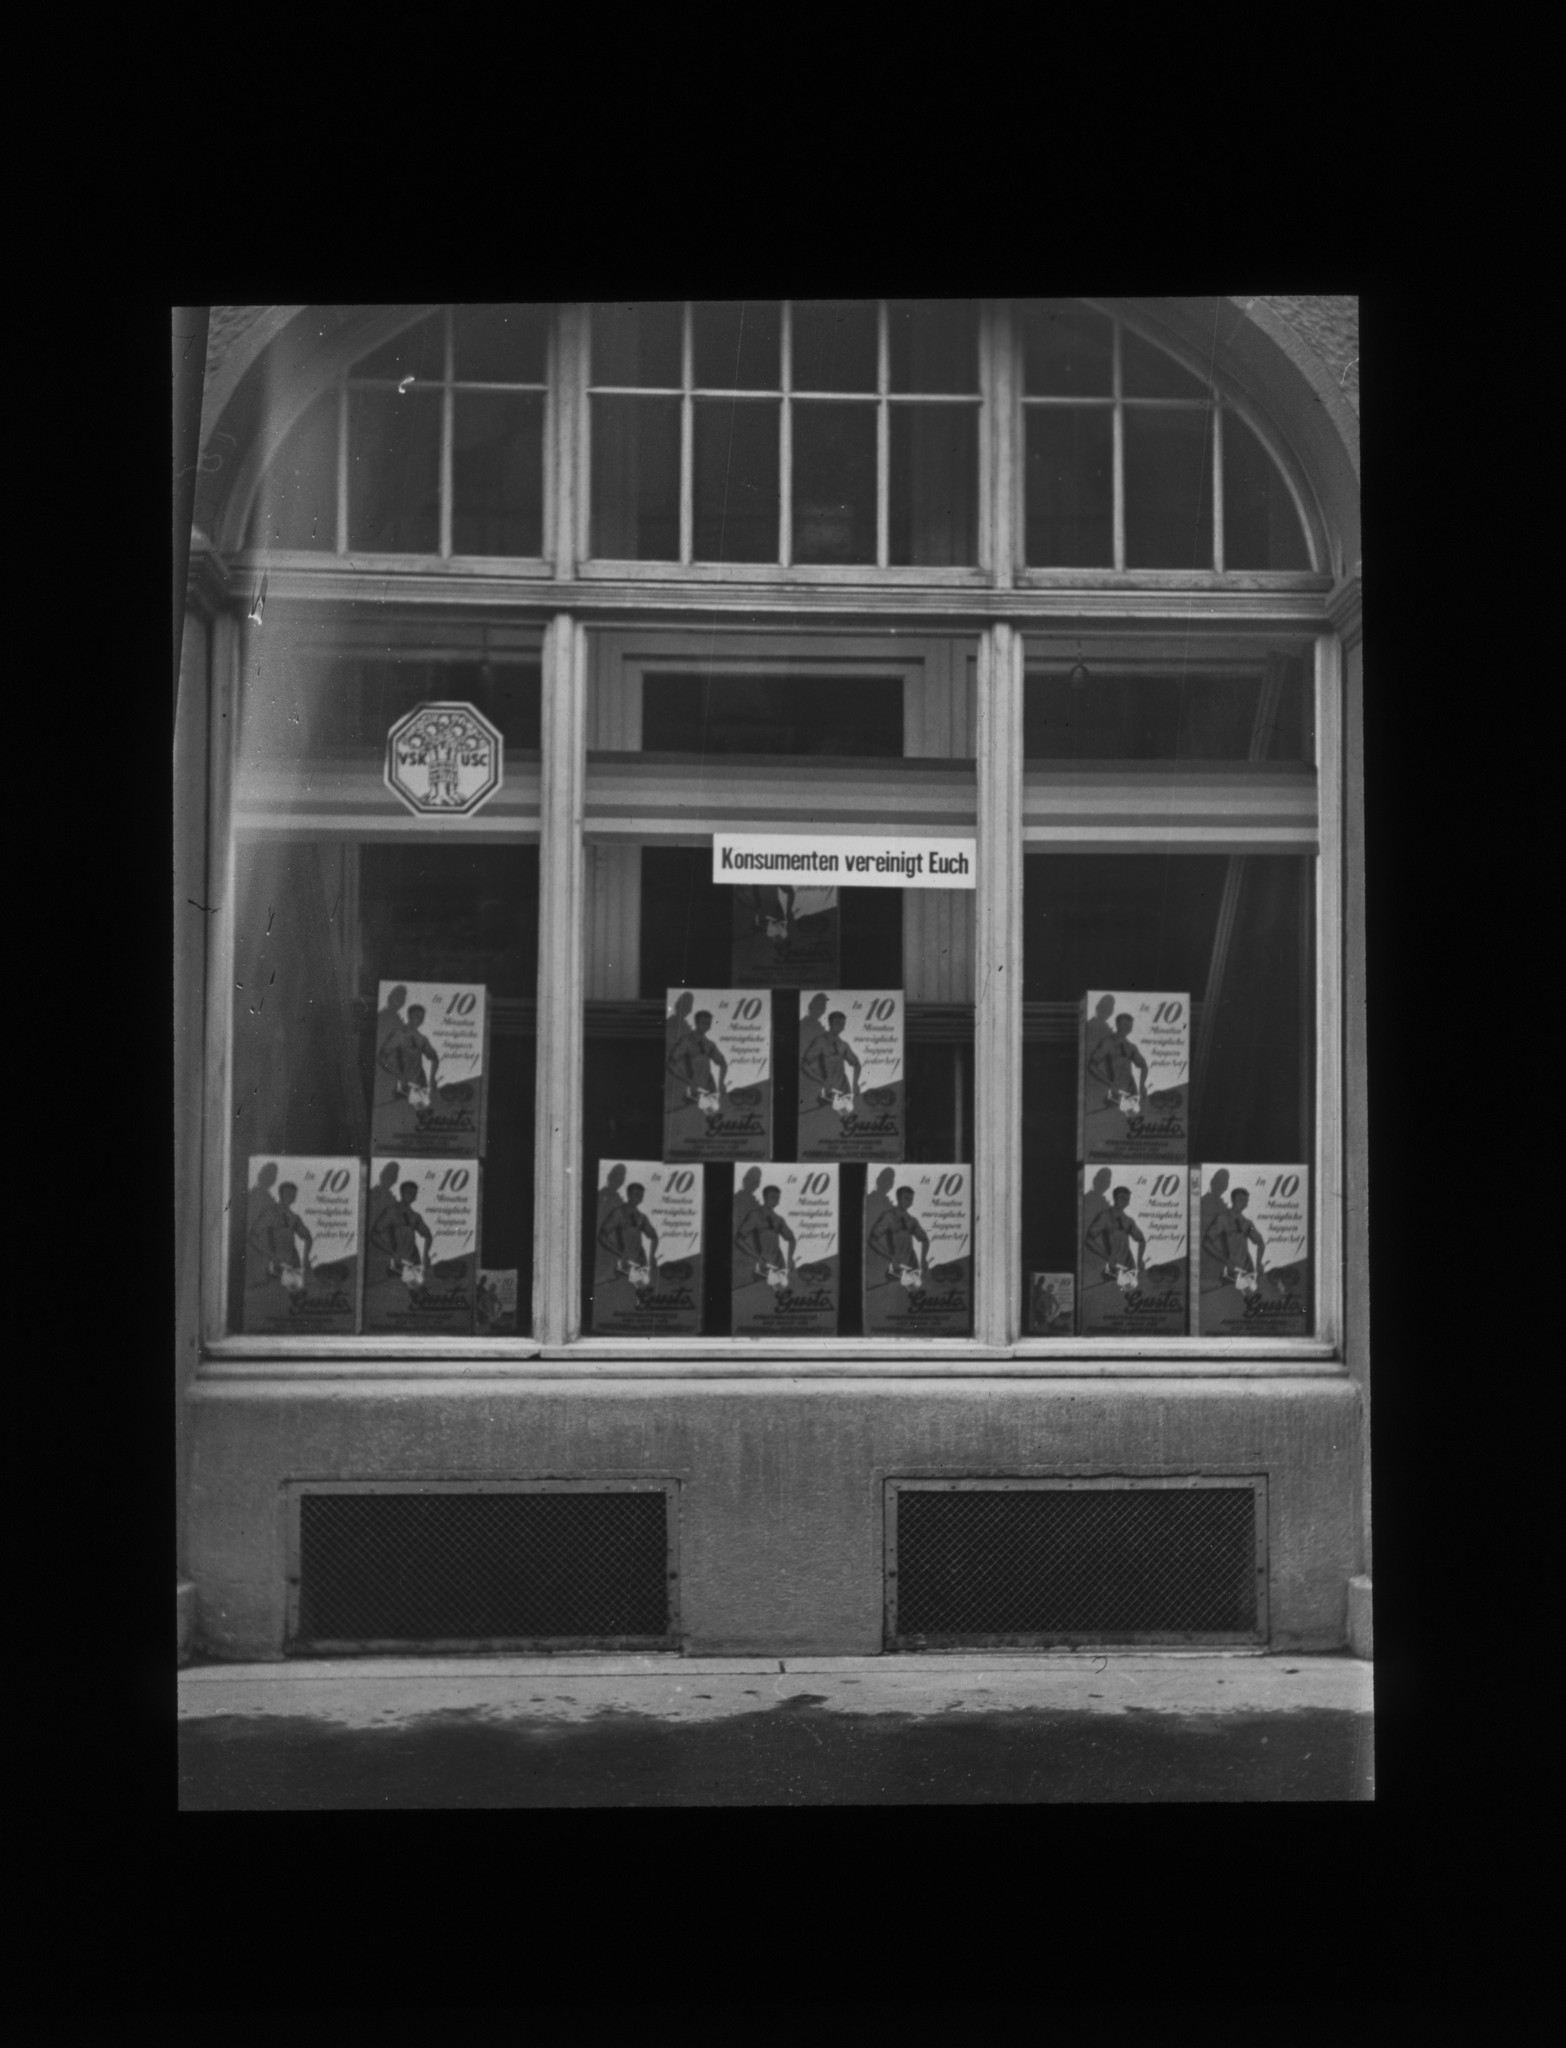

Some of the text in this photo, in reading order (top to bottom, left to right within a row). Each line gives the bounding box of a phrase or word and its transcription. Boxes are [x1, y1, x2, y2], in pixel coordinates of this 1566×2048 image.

[399, 752, 428, 766] VSK
[461, 753, 488, 767] USC
[721, 847, 969, 878] Konsumenten vereinigt Euch
[446, 992, 477, 1016] 10
[732, 997, 762, 1021] 10
[866, 998, 896, 1021] 10
[1153, 1001, 1182, 1024] 10
[705, 1113, 765, 1138] Gusto
[840, 1114, 899, 1138] Gusto
[1126, 1116, 1185, 1140] Gusto
[319, 1169, 350, 1193] 10
[439, 1169, 469, 1192] 10
[665, 1171, 694, 1194] 10
[800, 1172, 830, 1195] 10
[934, 1173, 963, 1196] 10
[1150, 1174, 1180, 1197] 10
[1269, 1174, 1300, 1198] 10
[635, 1287, 696, 1311] Gusto
[774, 1289, 835, 1313] Gusto
[908, 1289, 966, 1314] Gusto
[1124, 1290, 1183, 1314] Gusto
[1243, 1293, 1303, 1318] Gusto
